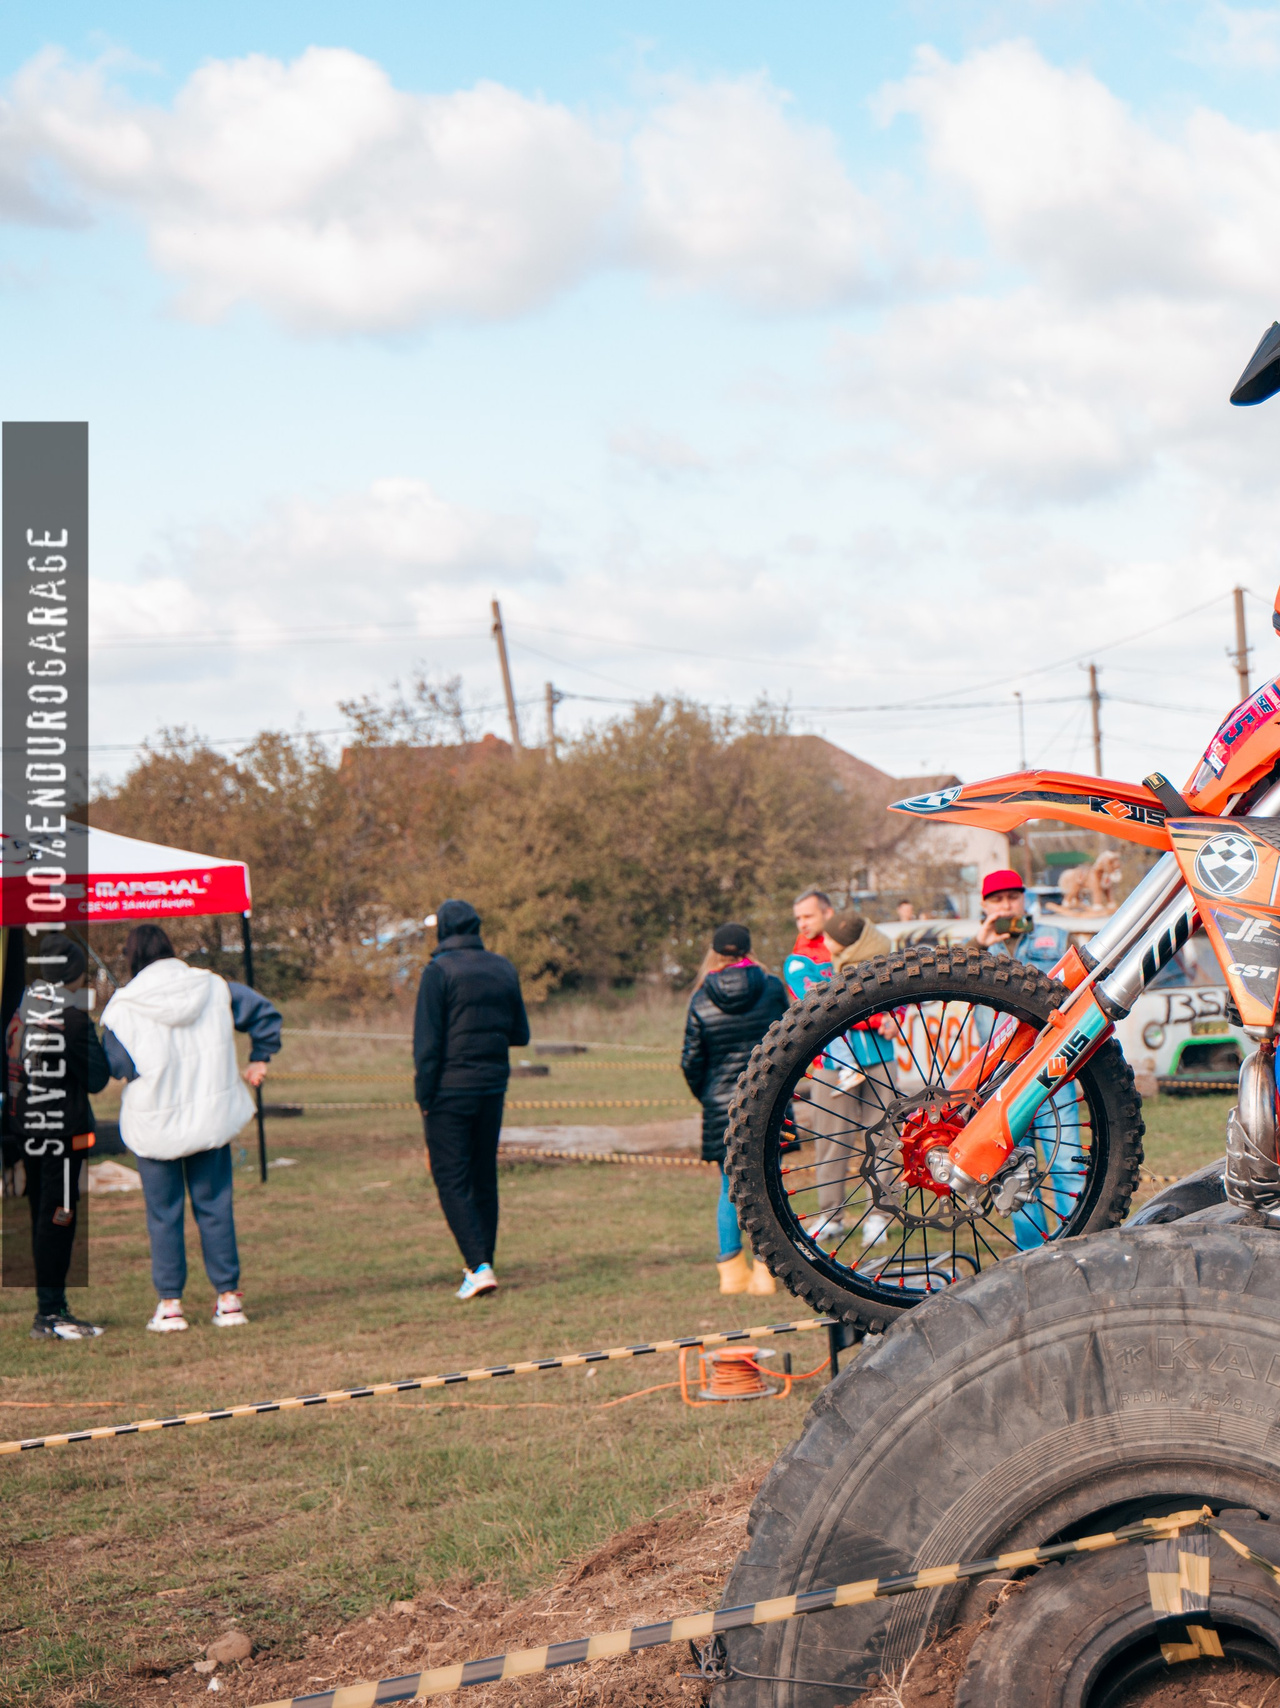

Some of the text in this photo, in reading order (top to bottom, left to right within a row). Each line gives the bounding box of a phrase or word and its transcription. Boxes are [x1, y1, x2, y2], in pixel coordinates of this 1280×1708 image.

[1224, 918, 1271, 942] JF
[1227, 963, 1277, 979] CST
[1036, 1028, 1091, 1090] KEWS
[1120, 1389, 1180, 1406] RADIAL
